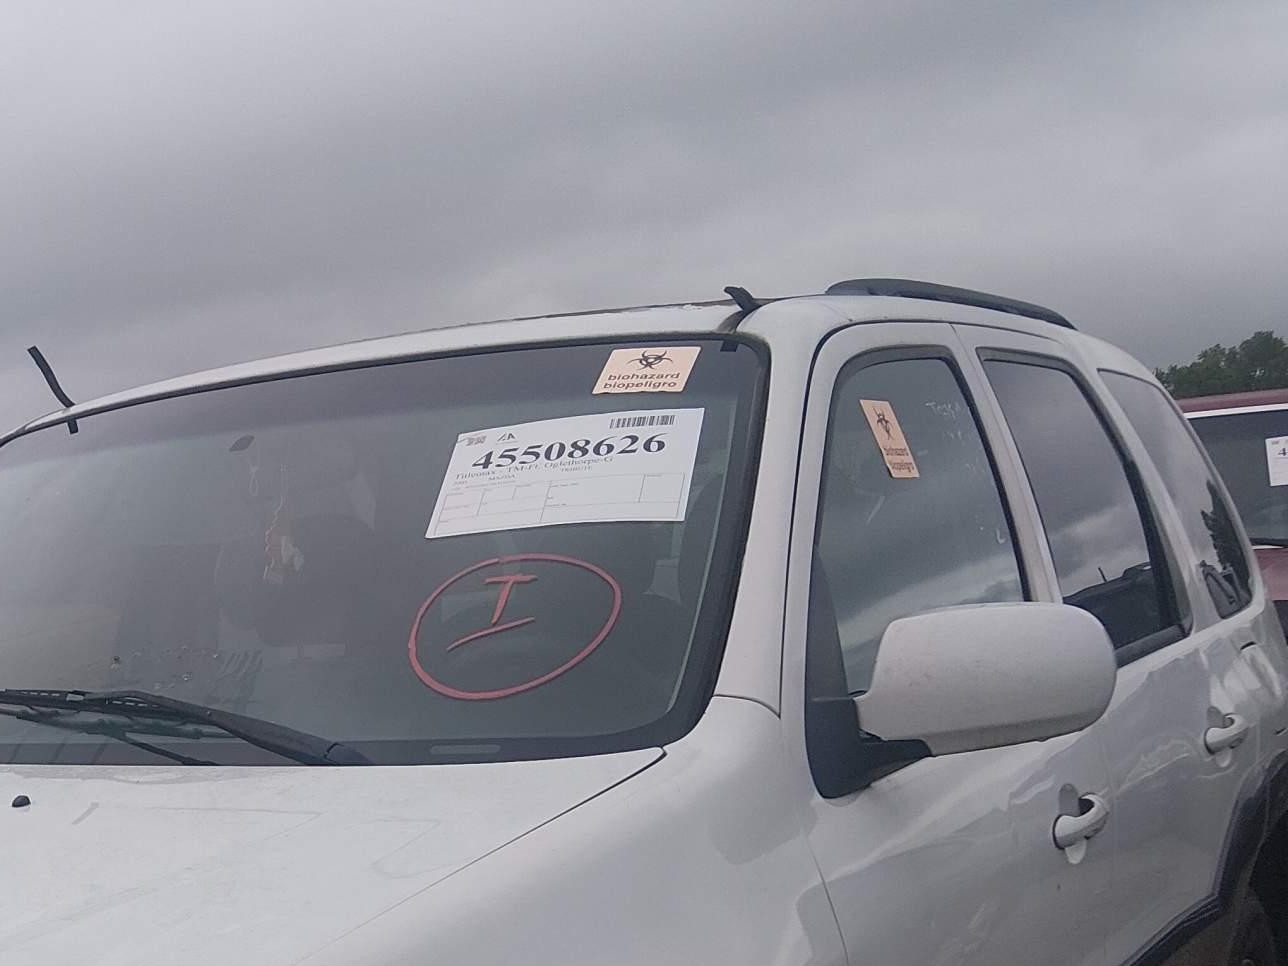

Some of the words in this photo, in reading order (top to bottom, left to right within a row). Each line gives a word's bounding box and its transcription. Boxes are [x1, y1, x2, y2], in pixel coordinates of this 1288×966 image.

[607, 372, 680, 380] biohazard
[603, 380, 677, 390] biopeligro
[472, 432, 669, 470] 45508626
